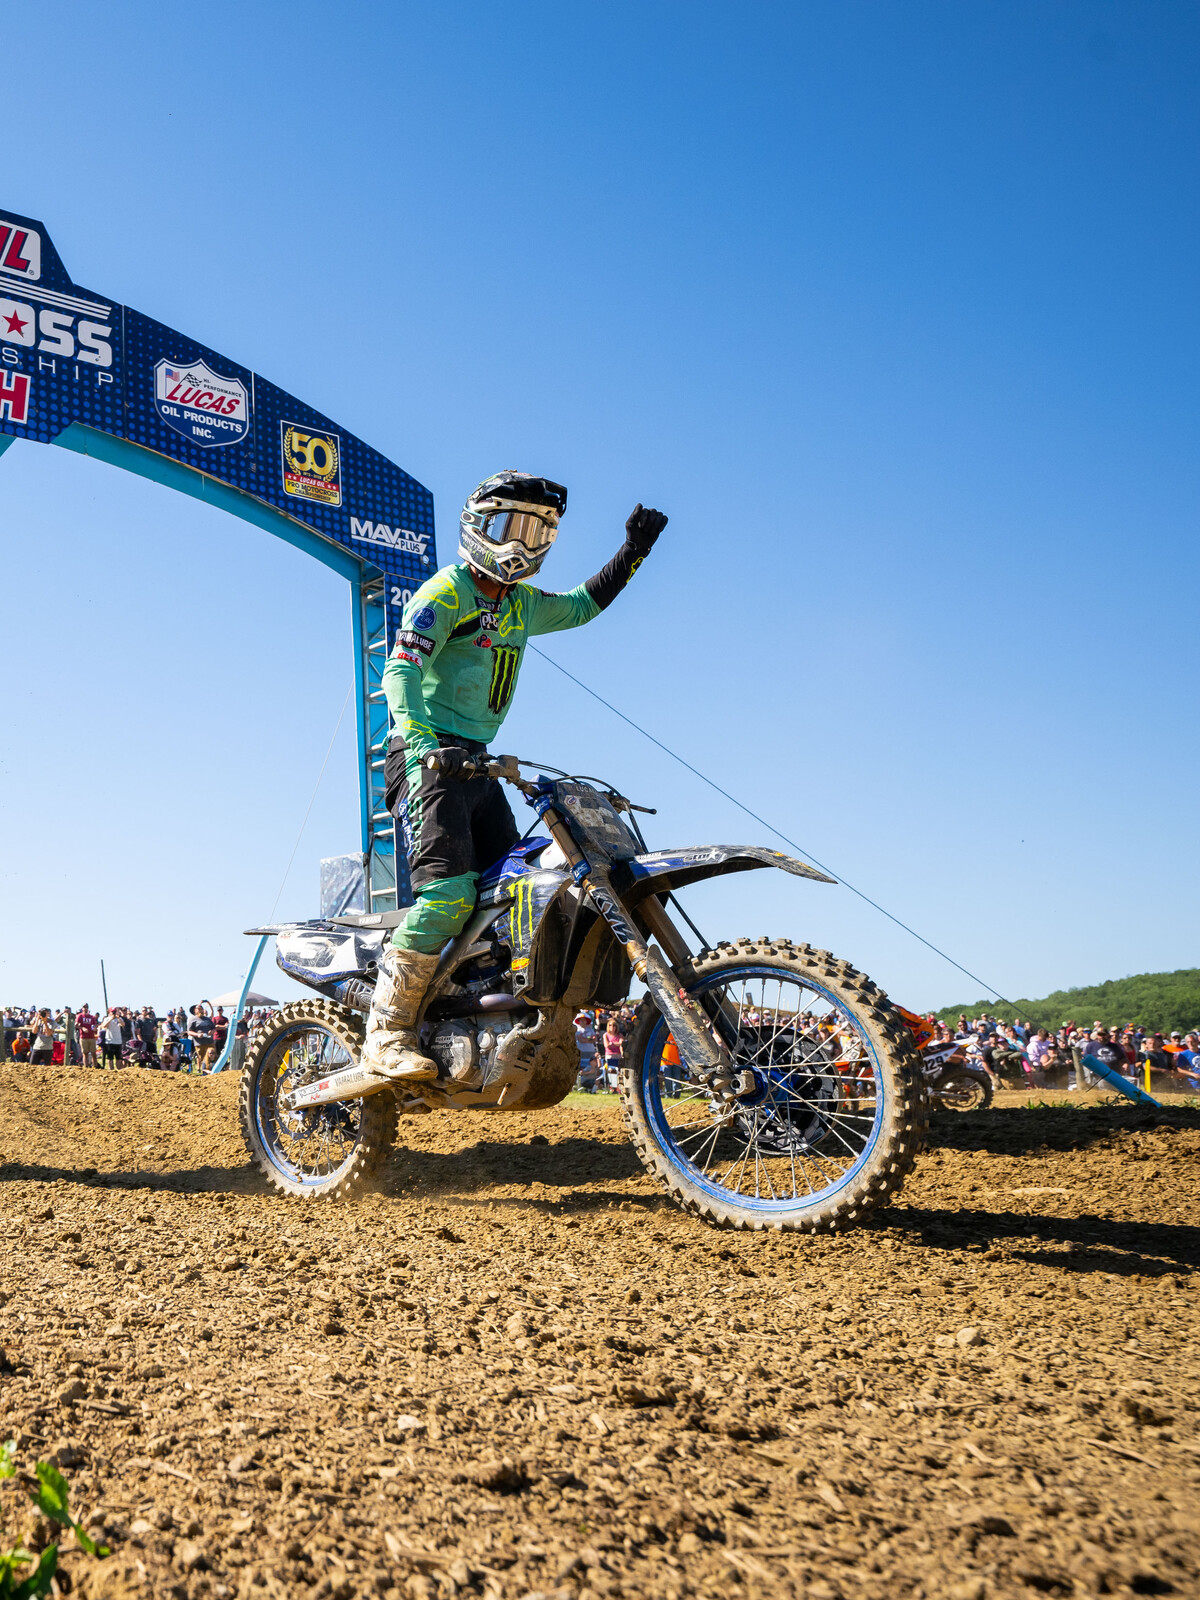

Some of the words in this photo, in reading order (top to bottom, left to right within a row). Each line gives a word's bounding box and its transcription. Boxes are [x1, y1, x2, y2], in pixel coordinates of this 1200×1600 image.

[166, 384, 240, 415] LUCAS
[161, 405, 180, 417] OIL
[183, 410, 243, 433] PRODUCTS
[291, 431, 333, 475] 50
[400, 540, 420, 553] PLUS
[397, 651, 420, 666] BELL
